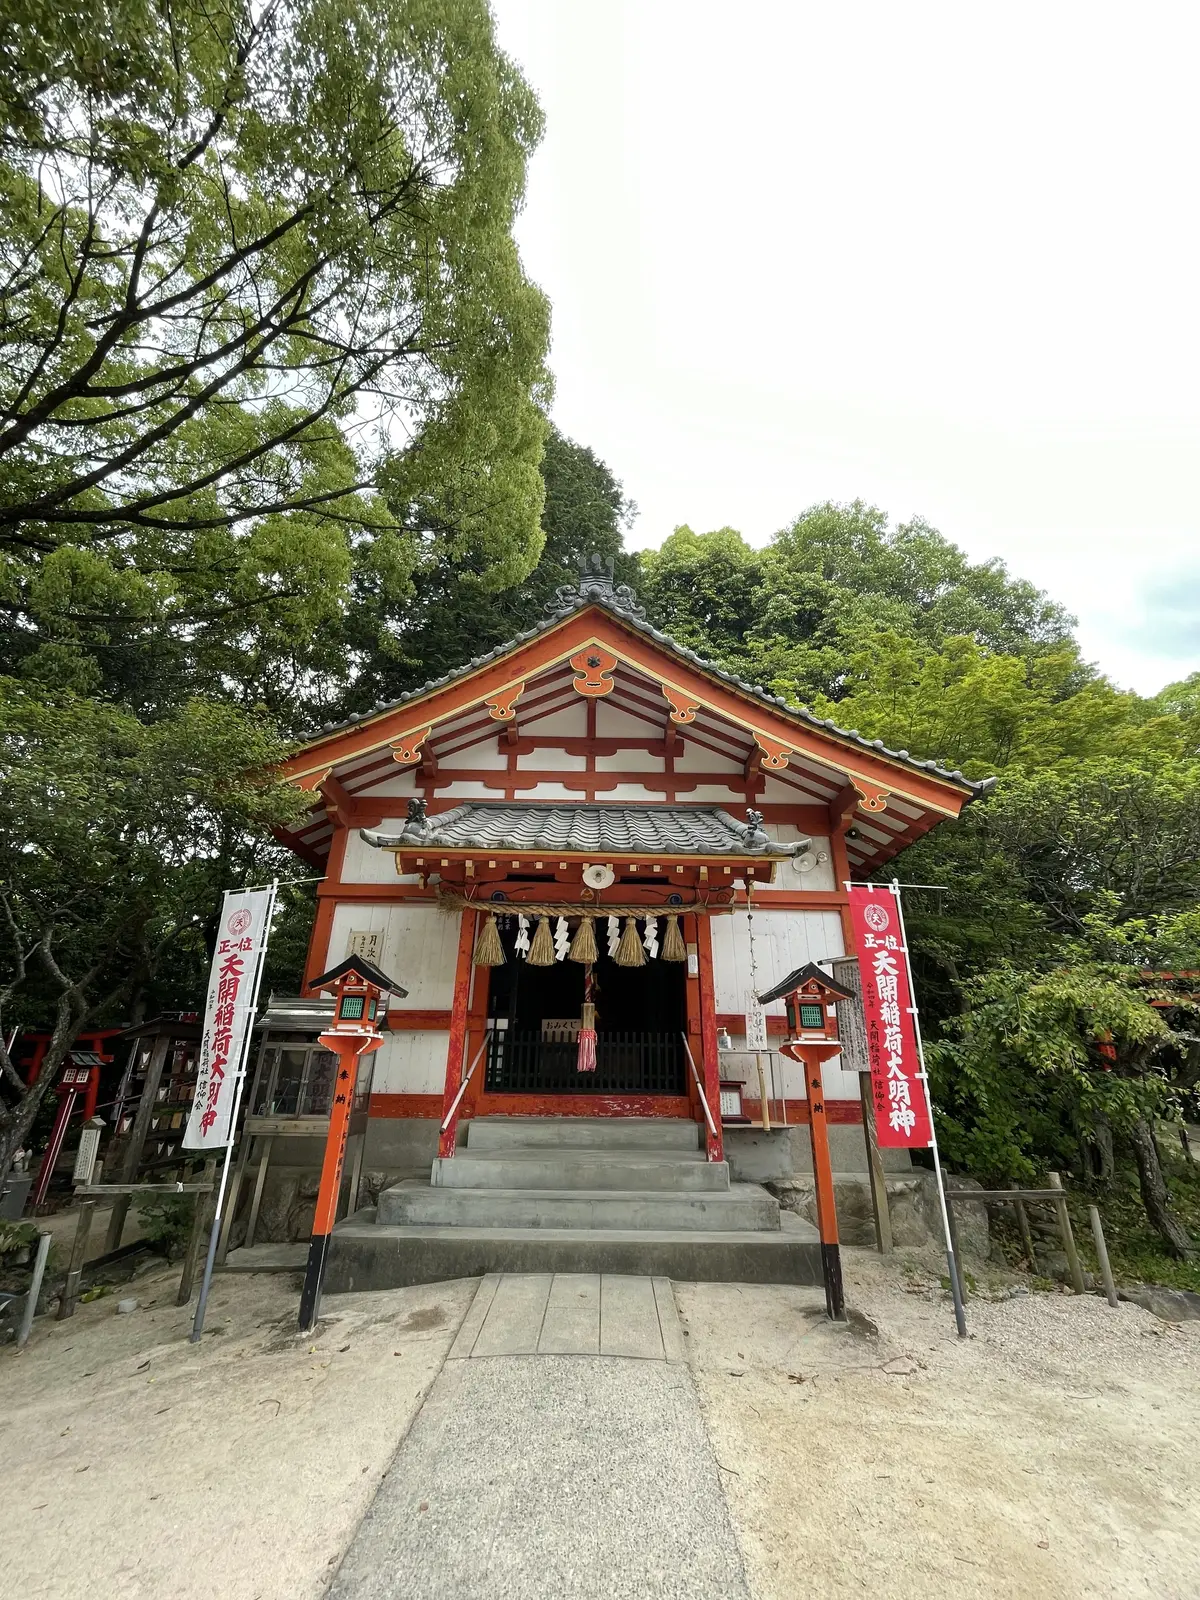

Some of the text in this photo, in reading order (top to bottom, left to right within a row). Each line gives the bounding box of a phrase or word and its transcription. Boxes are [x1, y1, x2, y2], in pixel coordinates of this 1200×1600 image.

[217, 936, 253, 955] 正一位
[864, 933, 899, 951] 正一位
[871, 950, 916, 1138] 天開稲荷大明神
[335, 1069, 350, 1106] 奉納
[811, 1078, 824, 1114] 奉納
